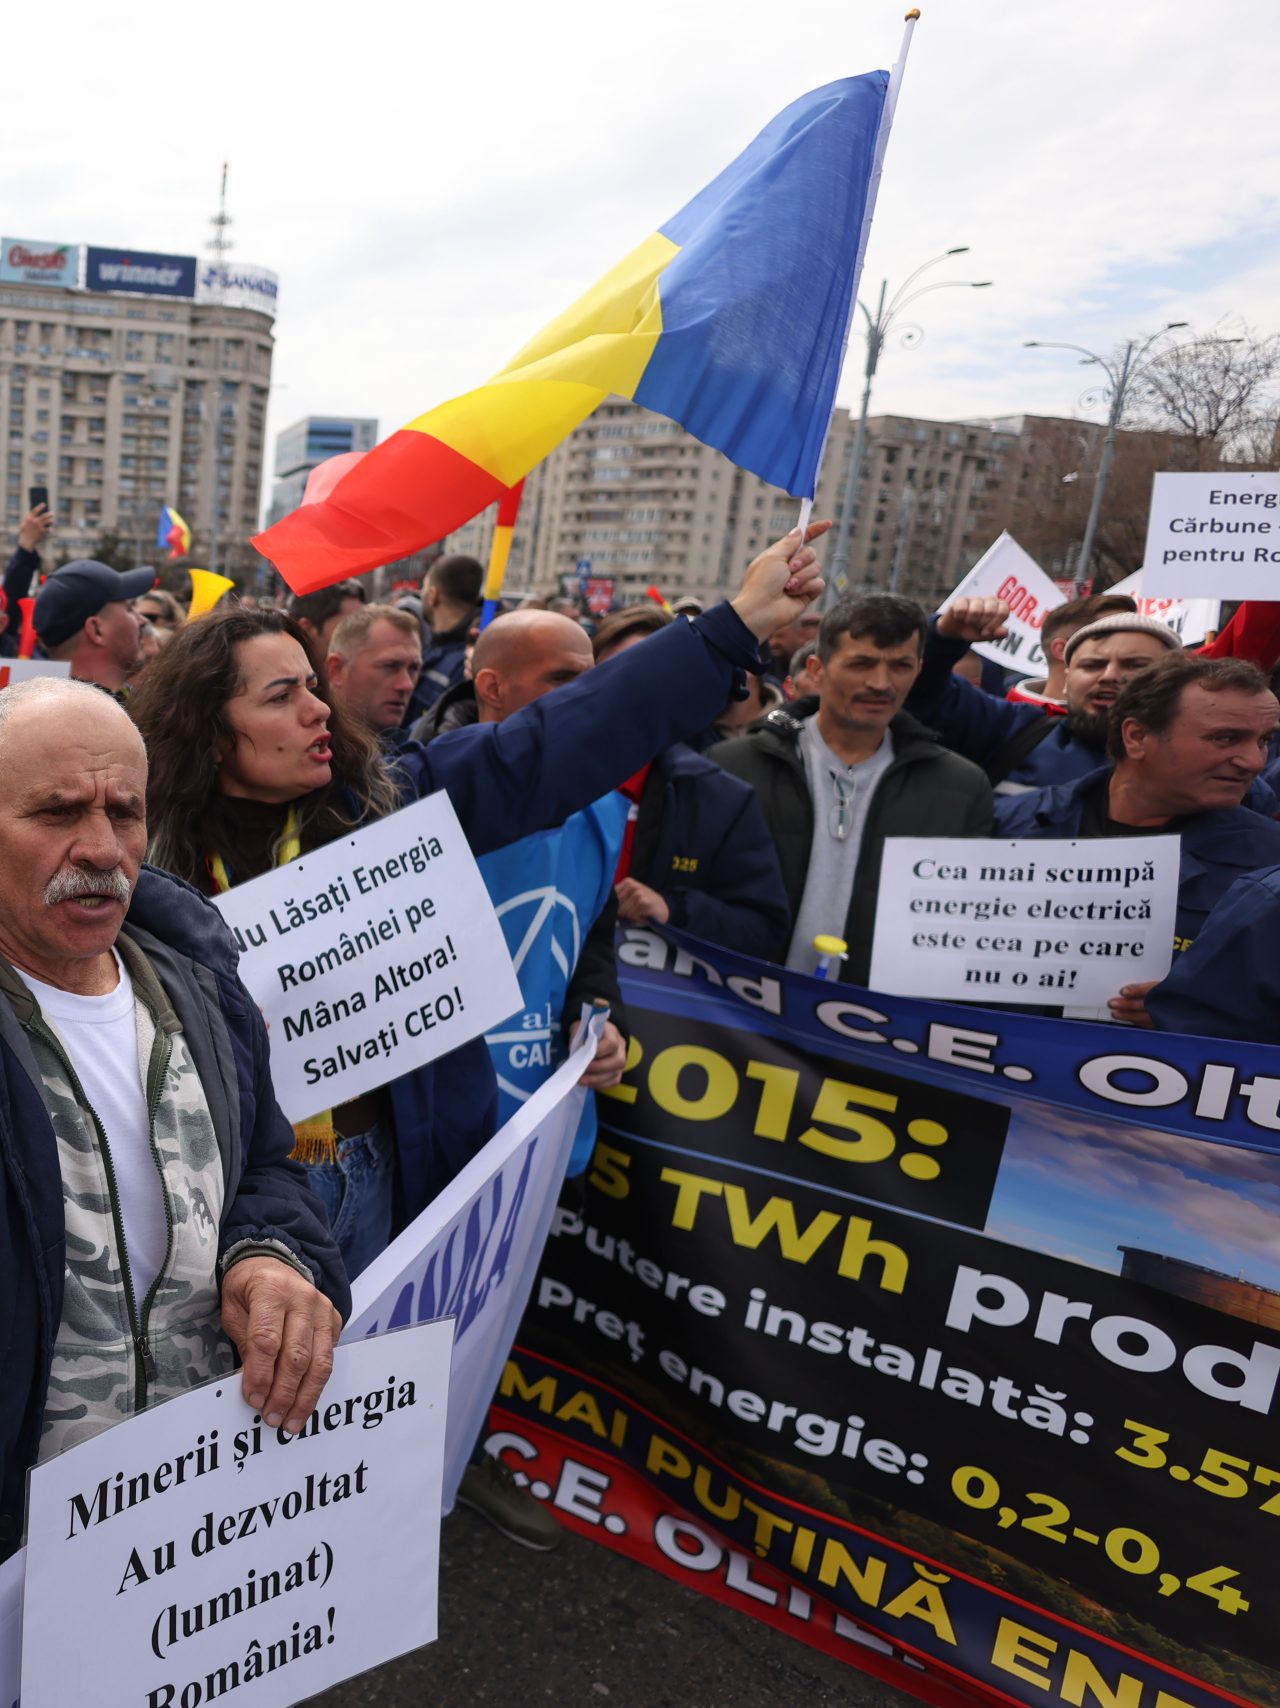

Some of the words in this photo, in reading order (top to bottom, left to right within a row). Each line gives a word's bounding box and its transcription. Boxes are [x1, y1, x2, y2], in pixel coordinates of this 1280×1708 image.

[98, 257, 183, 287] winner
[1169, 517, 1271, 534] Cărbune
[1209, 490, 1280, 509] Energ
[1162, 548, 1245, 565] pentru
[269, 876, 351, 935] Lăsați
[352, 836, 443, 896] Energia
[909, 897, 1017, 920] energie
[1027, 899, 1152, 920] electrică
[912, 859, 967, 881] Cea
[979, 862, 1035, 882] mai
[1045, 860, 1155, 888] scumpă
[277, 909, 401, 992] României
[405, 897, 437, 934] pe
[282, 991, 367, 1042] Mâna
[374, 935, 458, 1003] Altora!
[912, 930, 966, 948] este
[976, 934, 1023, 952] cea
[1031, 937, 1069, 958] pe
[1079, 939, 1145, 957] care
[965, 968, 1000, 985] nu
[1012, 971, 1028, 987] o
[1038, 969, 1078, 988] ai!
[303, 1021, 399, 1085] Salvați
[405, 986, 466, 1038] CEO!
[816, 1000, 1033, 1082] C.E.
[549, 1208, 727, 1317] Putere
[744, 1287, 1095, 1446] instalată:
[659, 1166, 910, 1295] TWh
[944, 1263, 1280, 1415] prod
[65, 1430, 220, 1540] Minerii
[233, 1415, 263, 1474] și
[538, 1277, 648, 1361] Preț
[658, 1350, 929, 1485] energie:
[951, 1465, 1250, 1616] 0,2-0,4
[116, 1541, 176, 1596] Au
[191, 1459, 369, 1558] dezvoltat
[499, 1359, 628, 1449] MAI
[645, 1434, 958, 1647] PUȚINĂ
[991, 1616, 1198, 1708] EN
[151, 1541, 334, 1659] (luminat)
